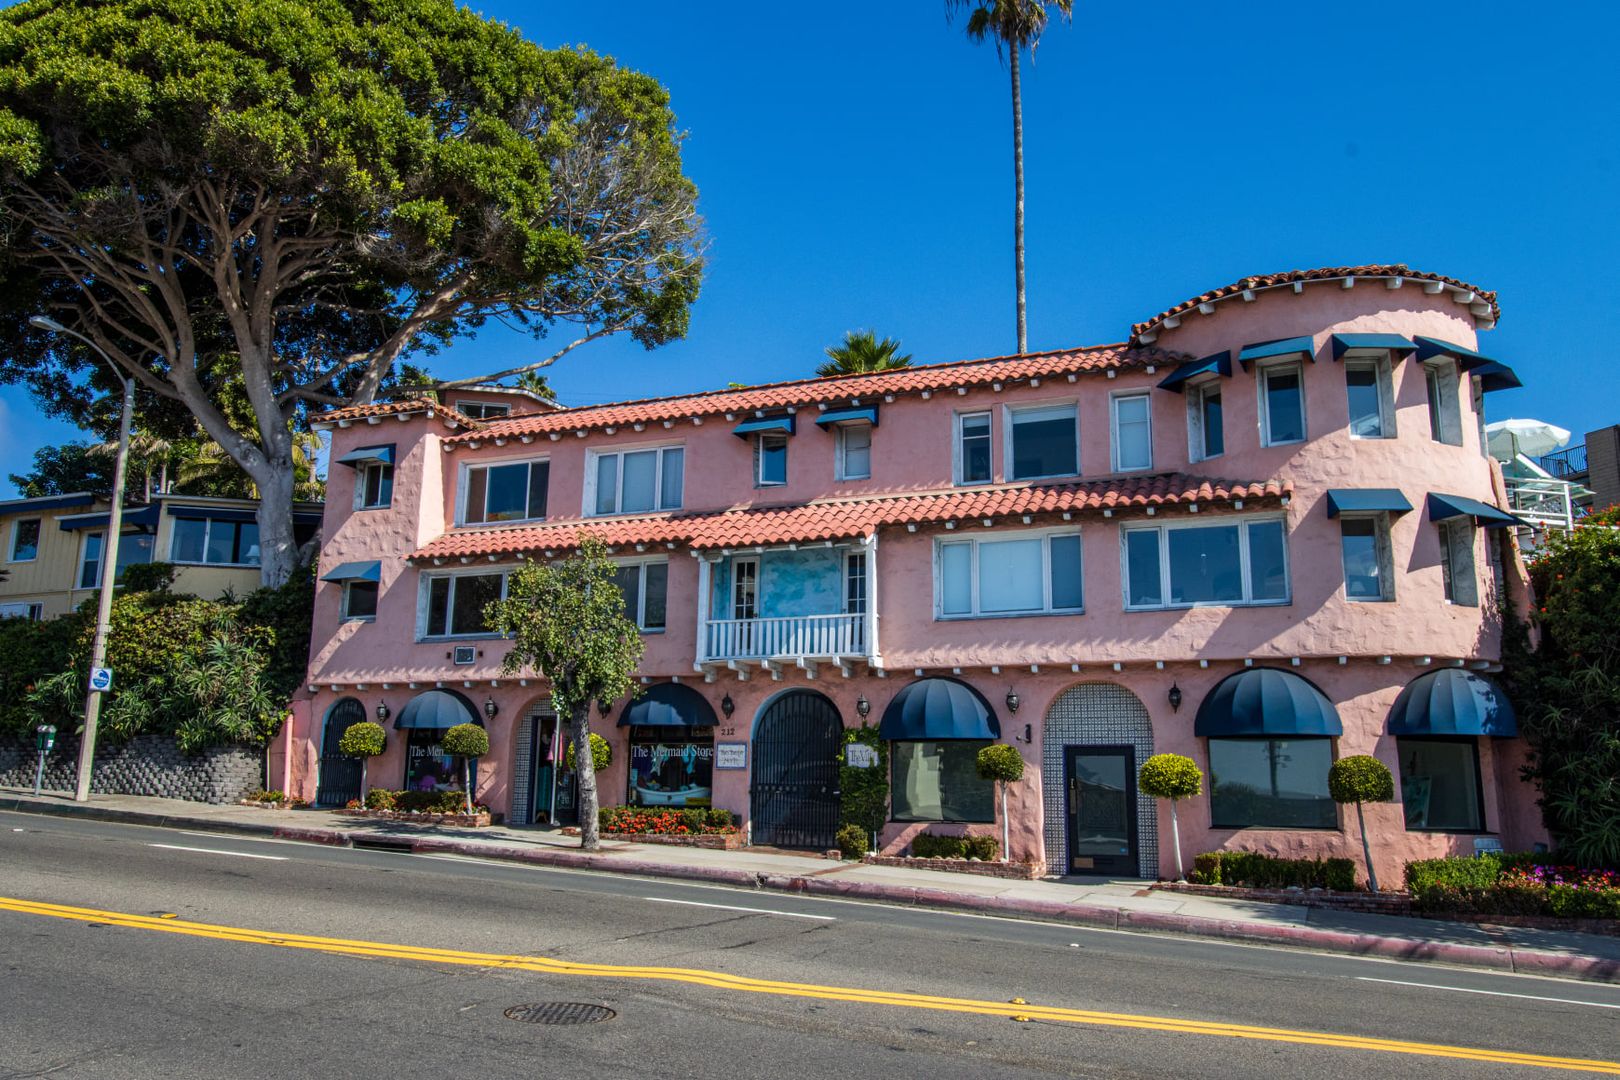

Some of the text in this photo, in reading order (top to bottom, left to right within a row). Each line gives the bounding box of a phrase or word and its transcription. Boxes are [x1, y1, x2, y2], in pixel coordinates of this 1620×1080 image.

[720, 728, 736, 736] 212
[410, 745, 425, 757] The
[631, 745, 649, 757] The
[650, 744, 689, 757] Mermaid
[691, 744, 714, 758] Store
